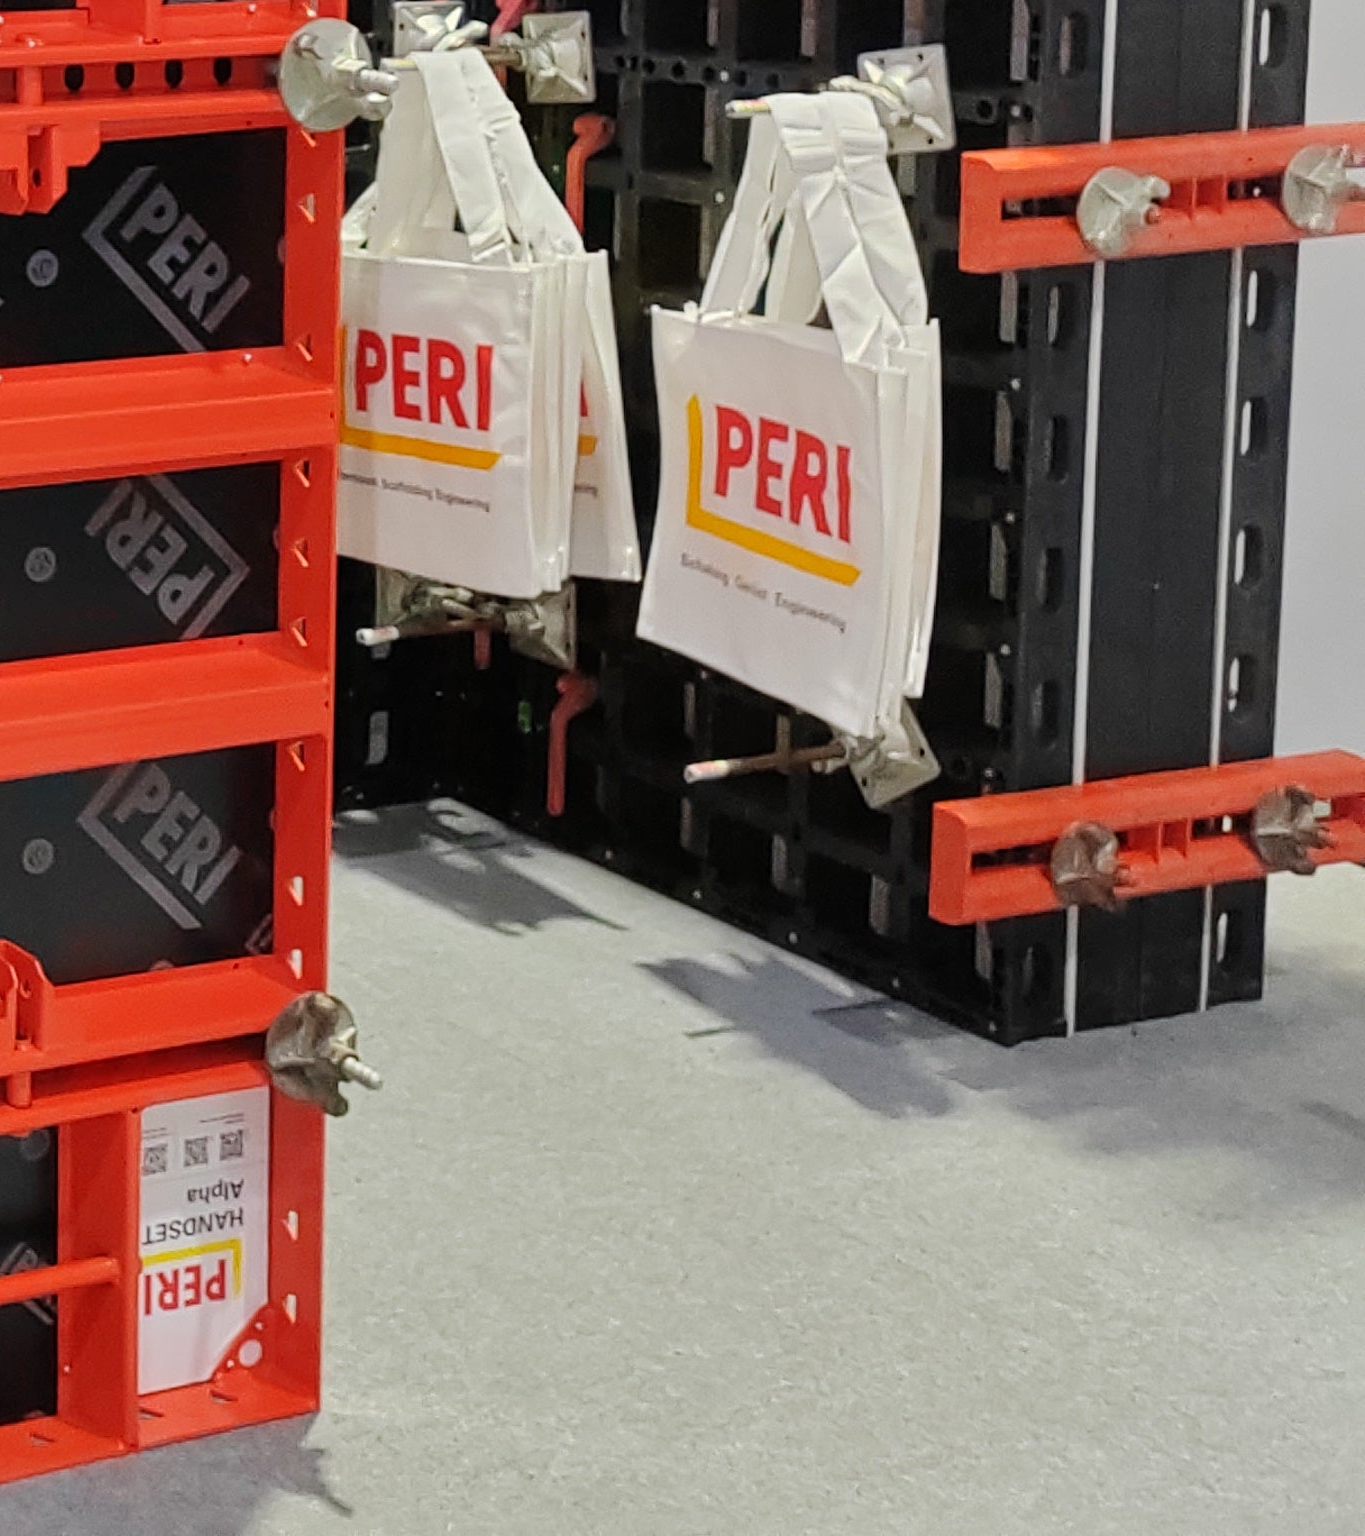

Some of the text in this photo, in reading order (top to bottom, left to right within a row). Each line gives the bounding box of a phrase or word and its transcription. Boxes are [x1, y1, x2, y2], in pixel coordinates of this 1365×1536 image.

[119, 183, 251, 334] PERI
[354, 327, 494, 432] PERI
[713, 404, 851, 544] PERI
[83, 477, 215, 626] PERI
[113, 762, 242, 905] PERI
[142, 1207, 245, 1246] HANDSET
[187, 1178, 245, 1204] Alpha
[143, 1259, 226, 1316] PERI
